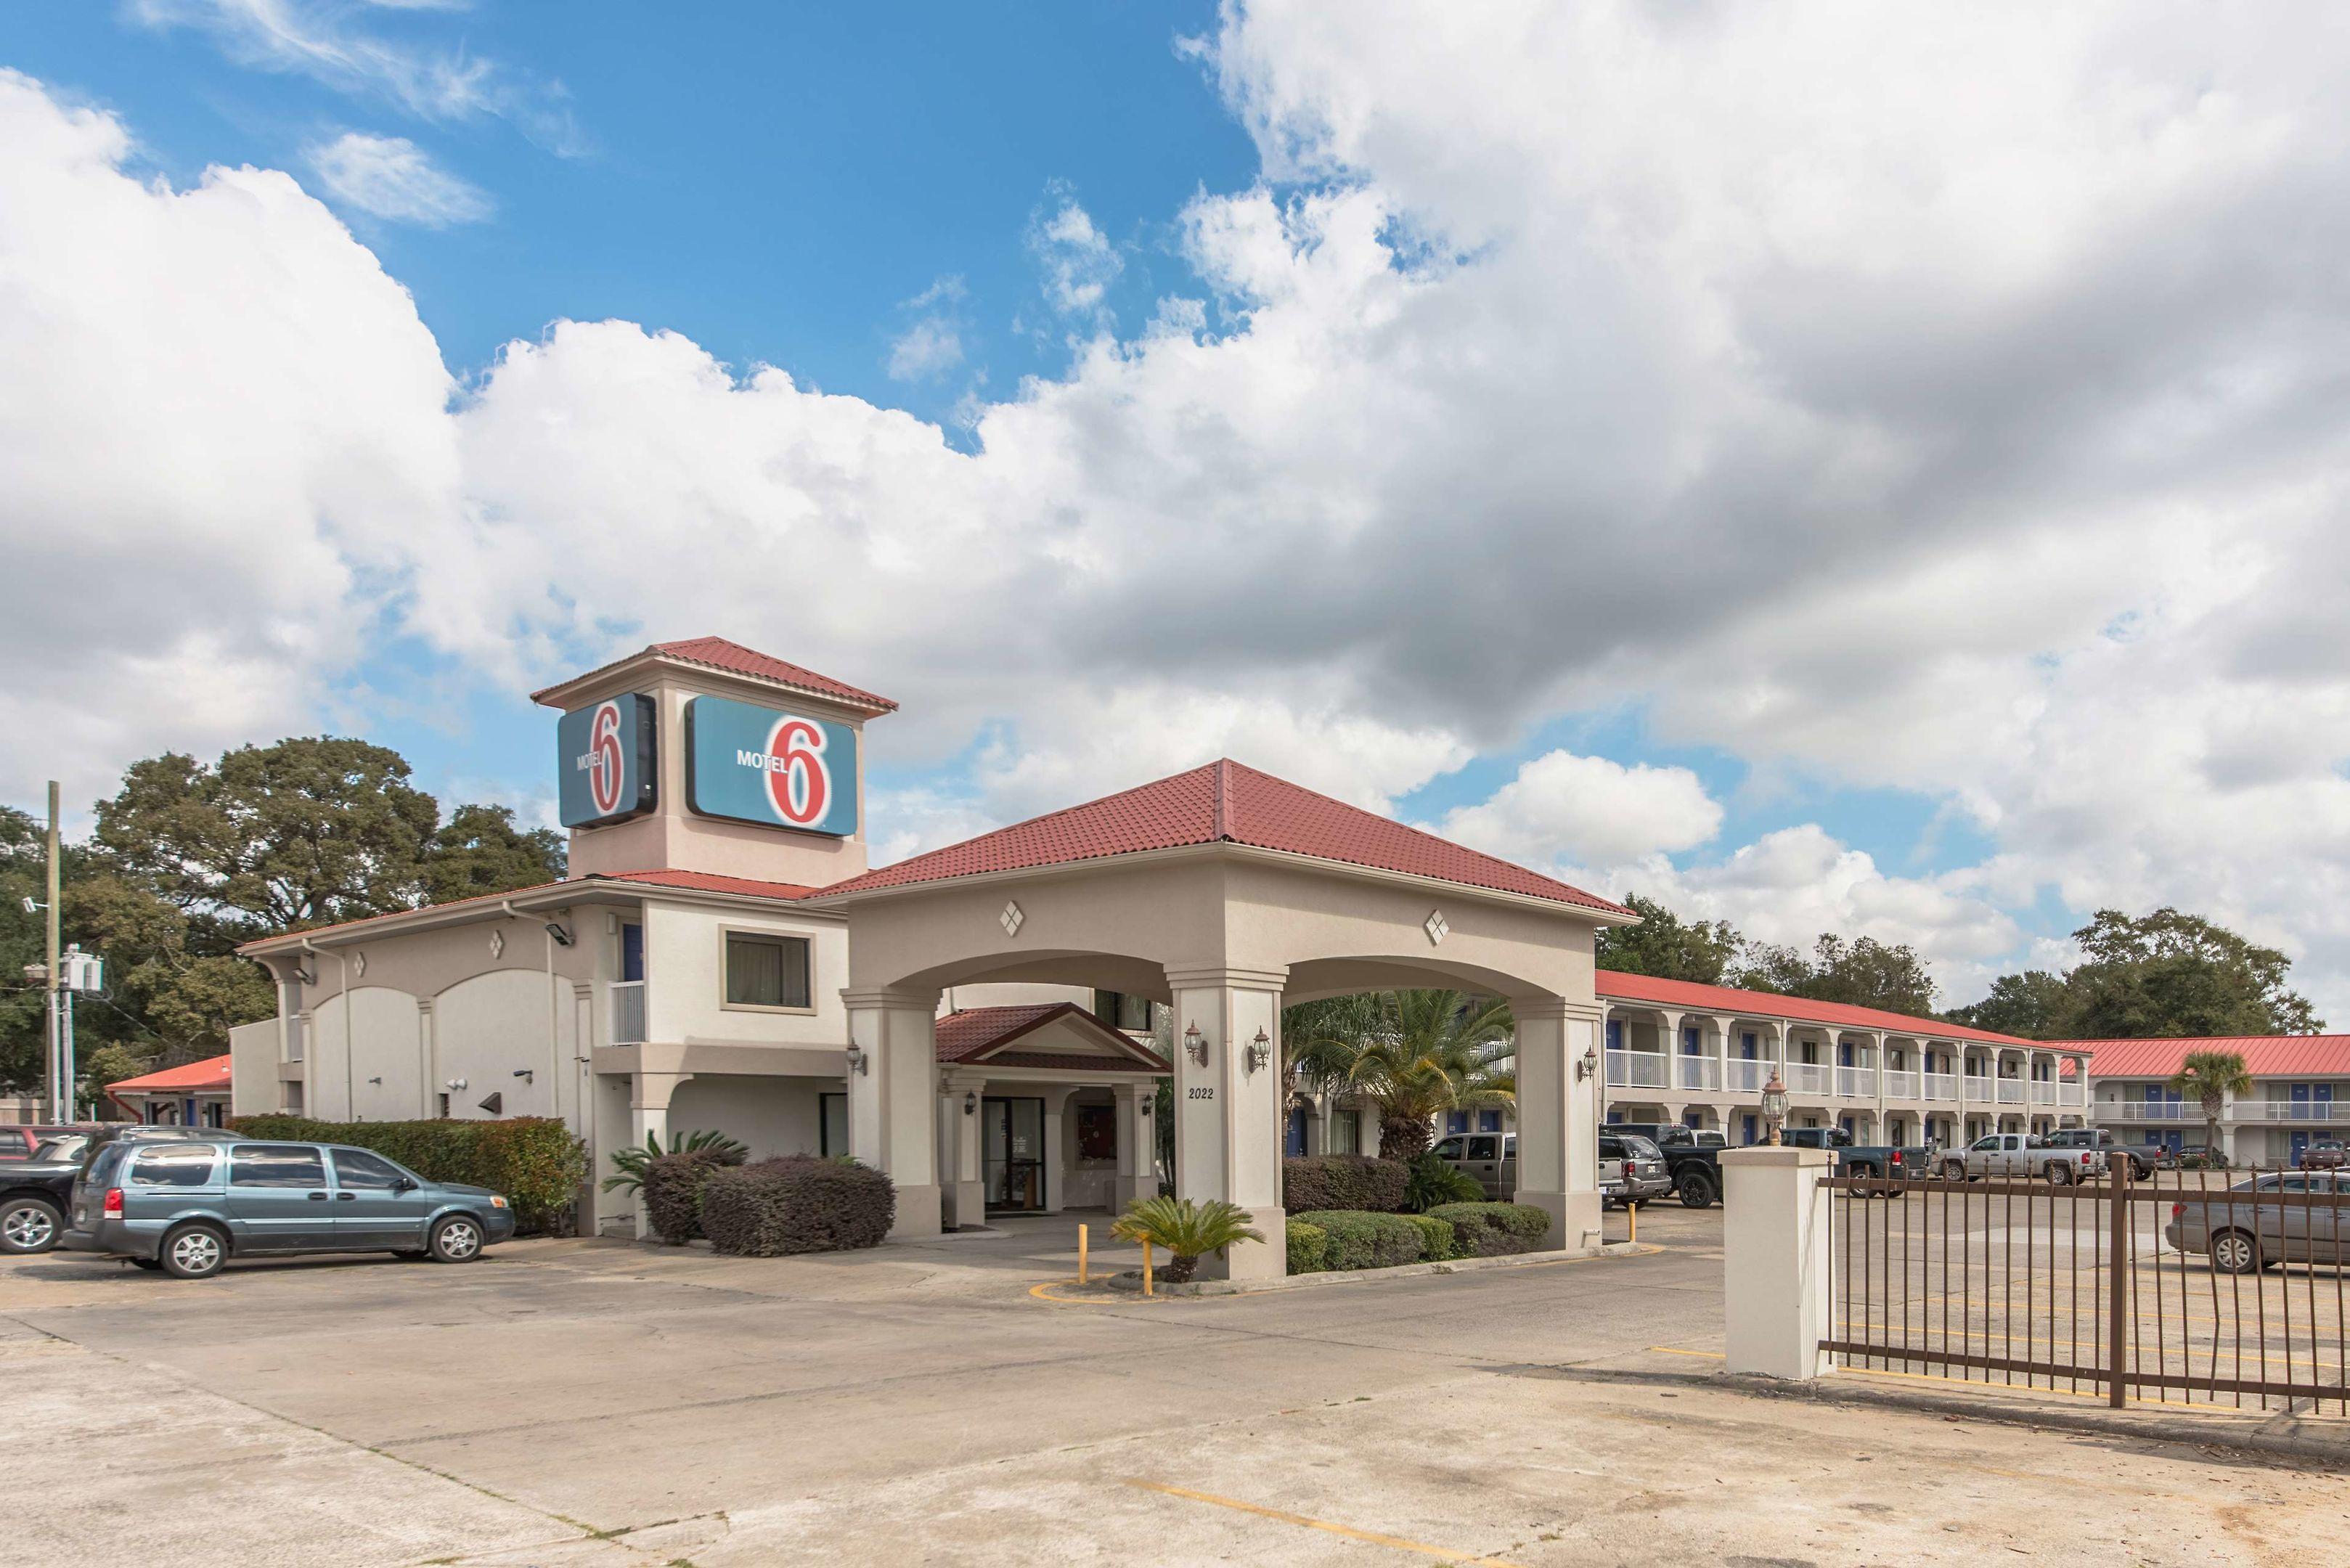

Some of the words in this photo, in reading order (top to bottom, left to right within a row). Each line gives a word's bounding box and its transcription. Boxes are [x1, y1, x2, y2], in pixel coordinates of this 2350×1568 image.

[577, 751, 602, 771] MOTEL
[591, 703, 622, 814] 6
[737, 749, 788, 774] MOTEL
[768, 719, 828, 825] 6
[1188, 1087, 1213, 1099] 2022
